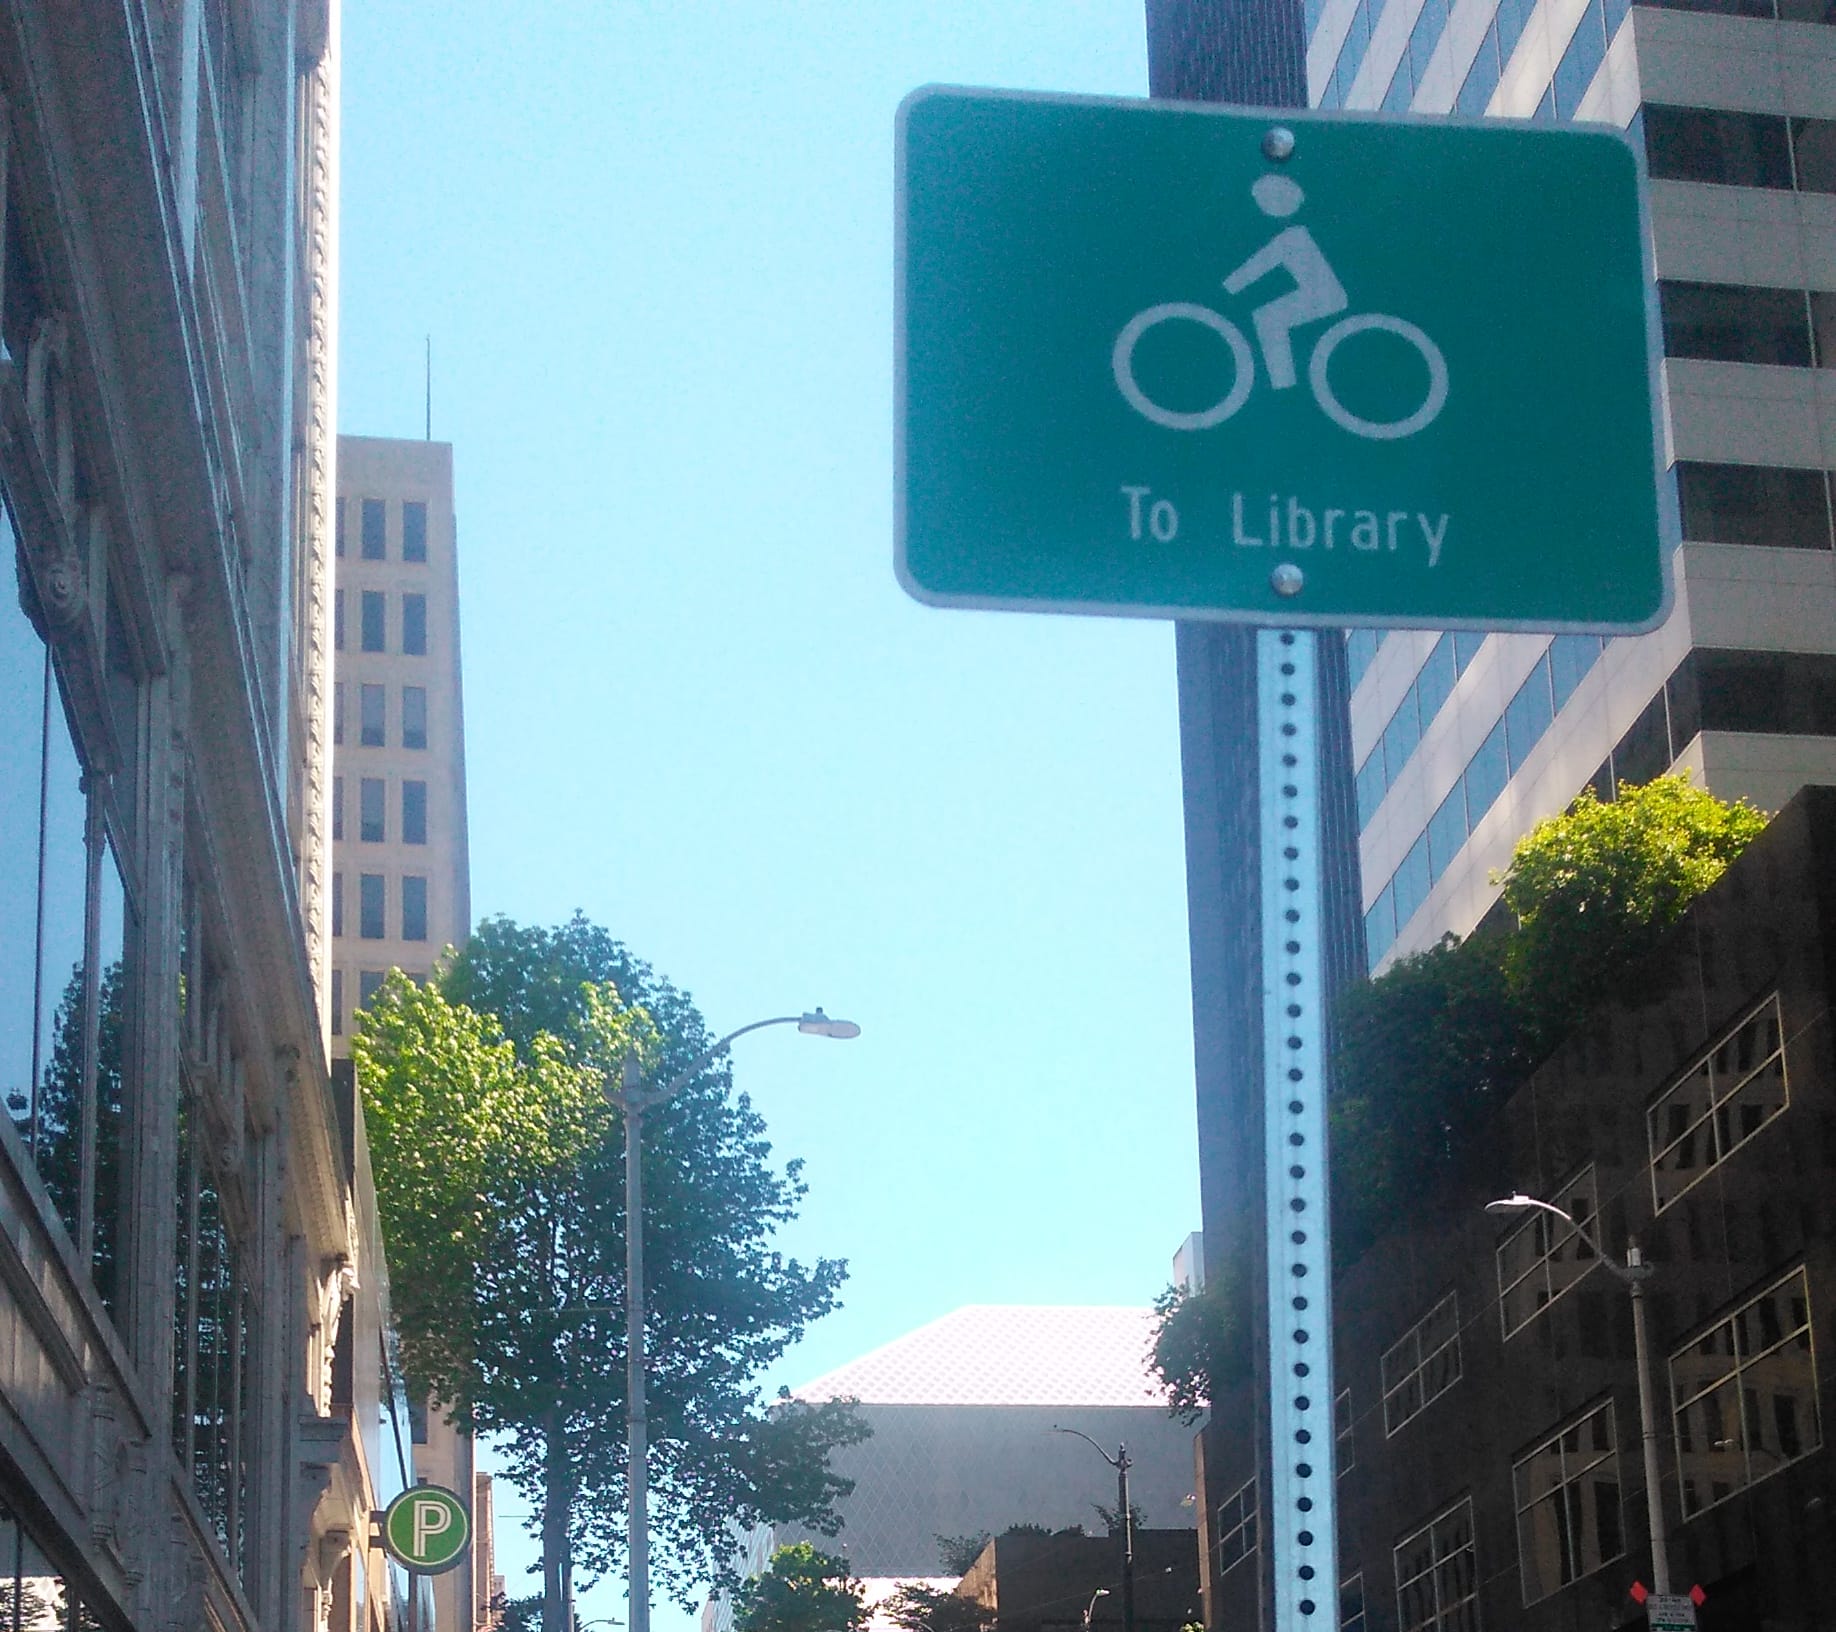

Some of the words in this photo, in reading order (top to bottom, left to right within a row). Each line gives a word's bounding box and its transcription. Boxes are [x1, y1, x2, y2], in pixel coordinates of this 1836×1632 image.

[1121, 486, 1179, 542] To
[1232, 492, 1449, 567] Library
[413, 1500, 452, 1557] P
